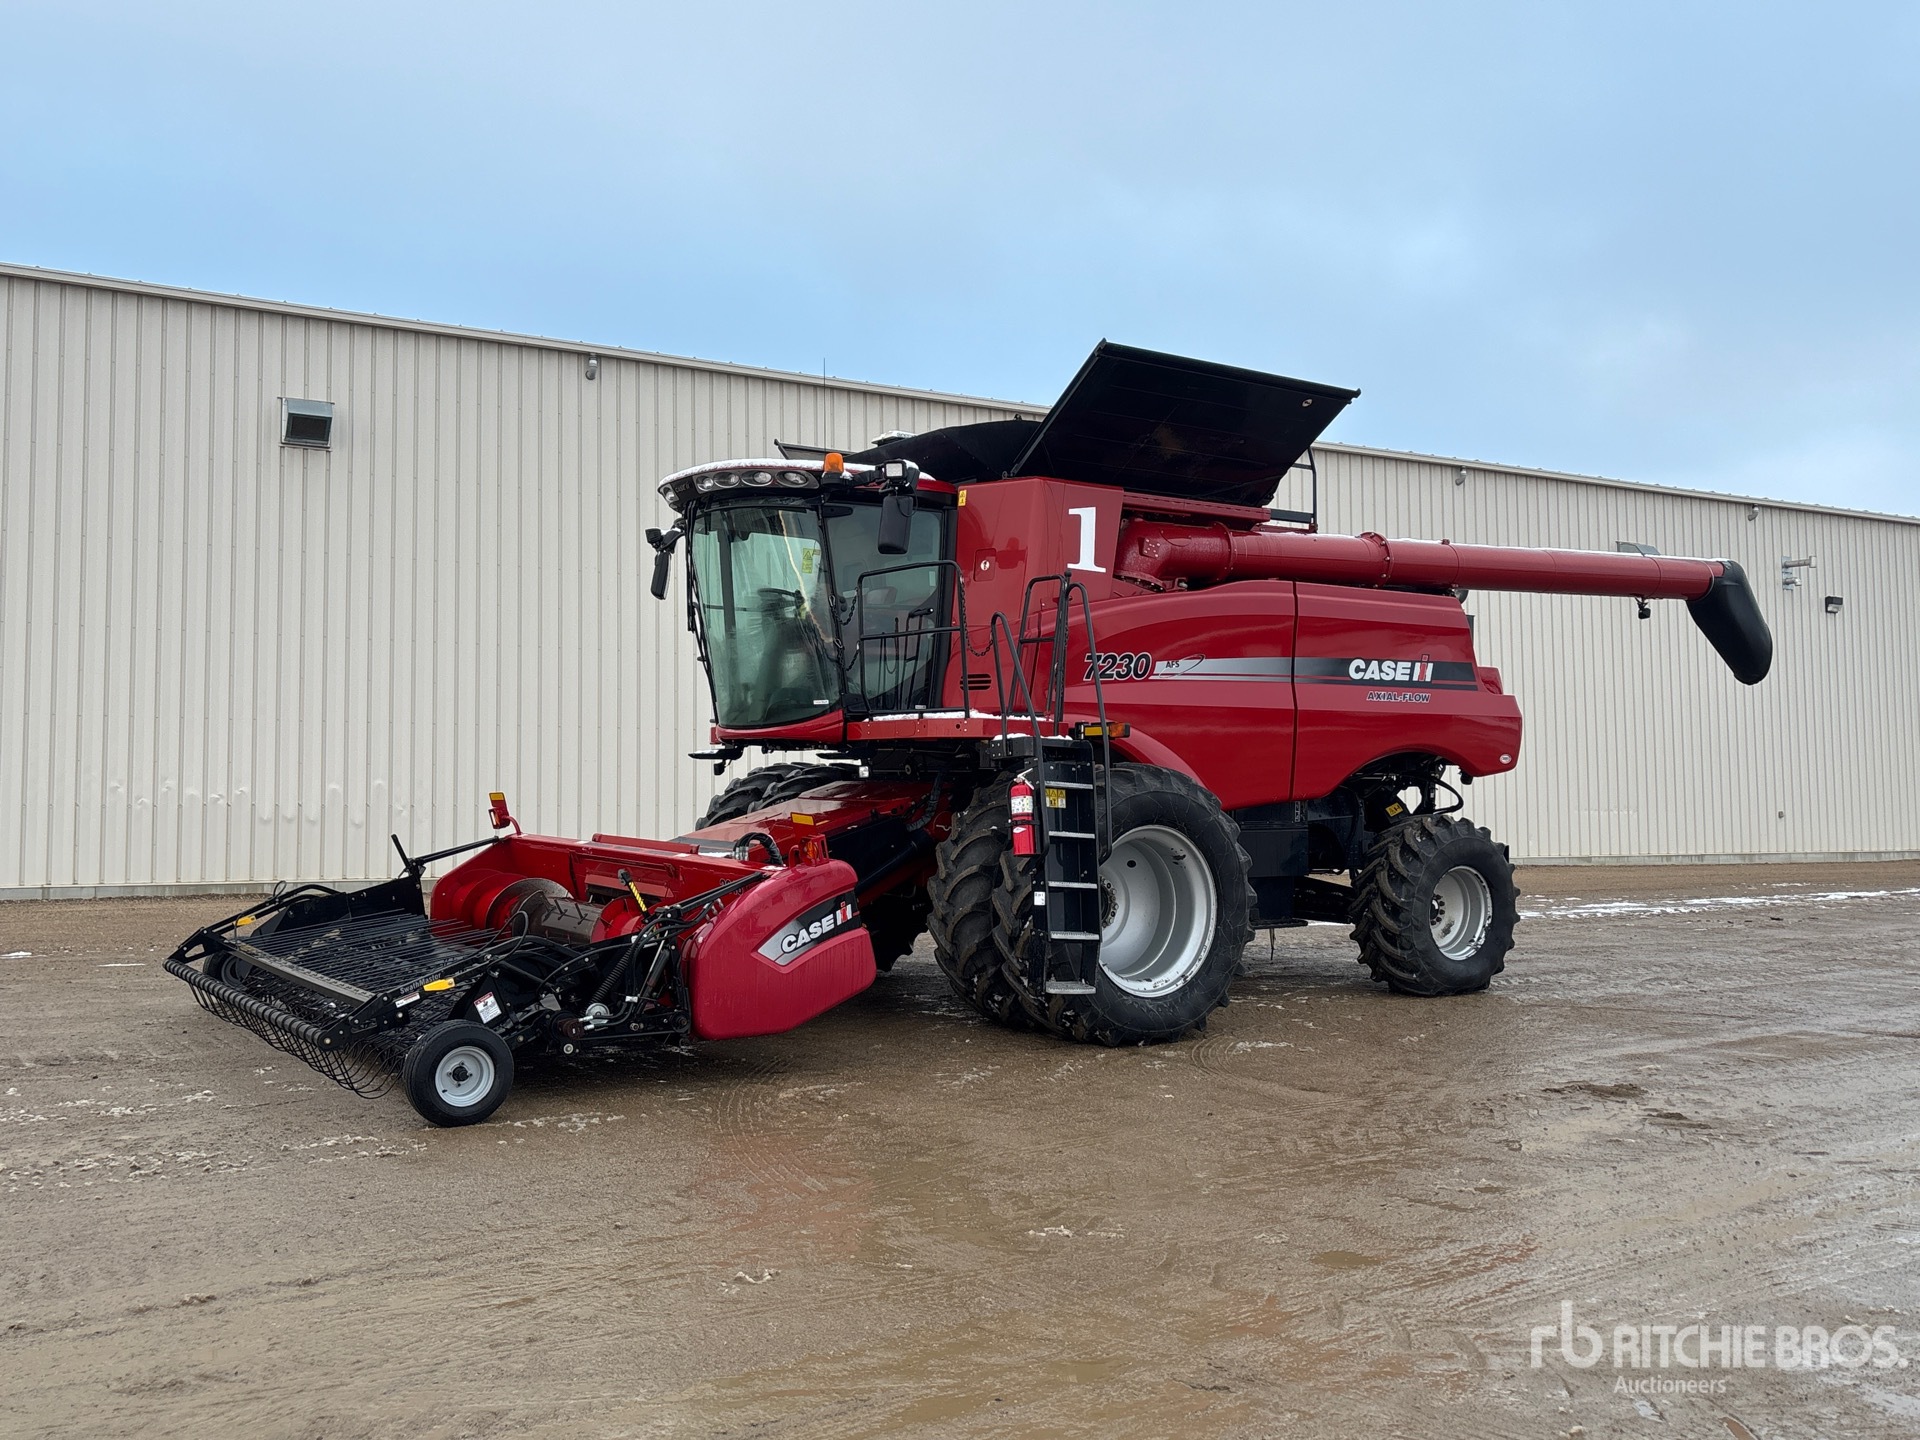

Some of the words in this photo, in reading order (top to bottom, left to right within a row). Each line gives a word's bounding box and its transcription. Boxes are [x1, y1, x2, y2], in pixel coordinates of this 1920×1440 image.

[1067, 506, 1106, 573] 1
[1083, 652, 1152, 681] 7230
[1165, 660, 1180, 669] AFS
[1349, 659, 1411, 682] CASE
[1366, 691, 1431, 703] AXIAL-FLOW
[781, 912, 835, 954] CASE
